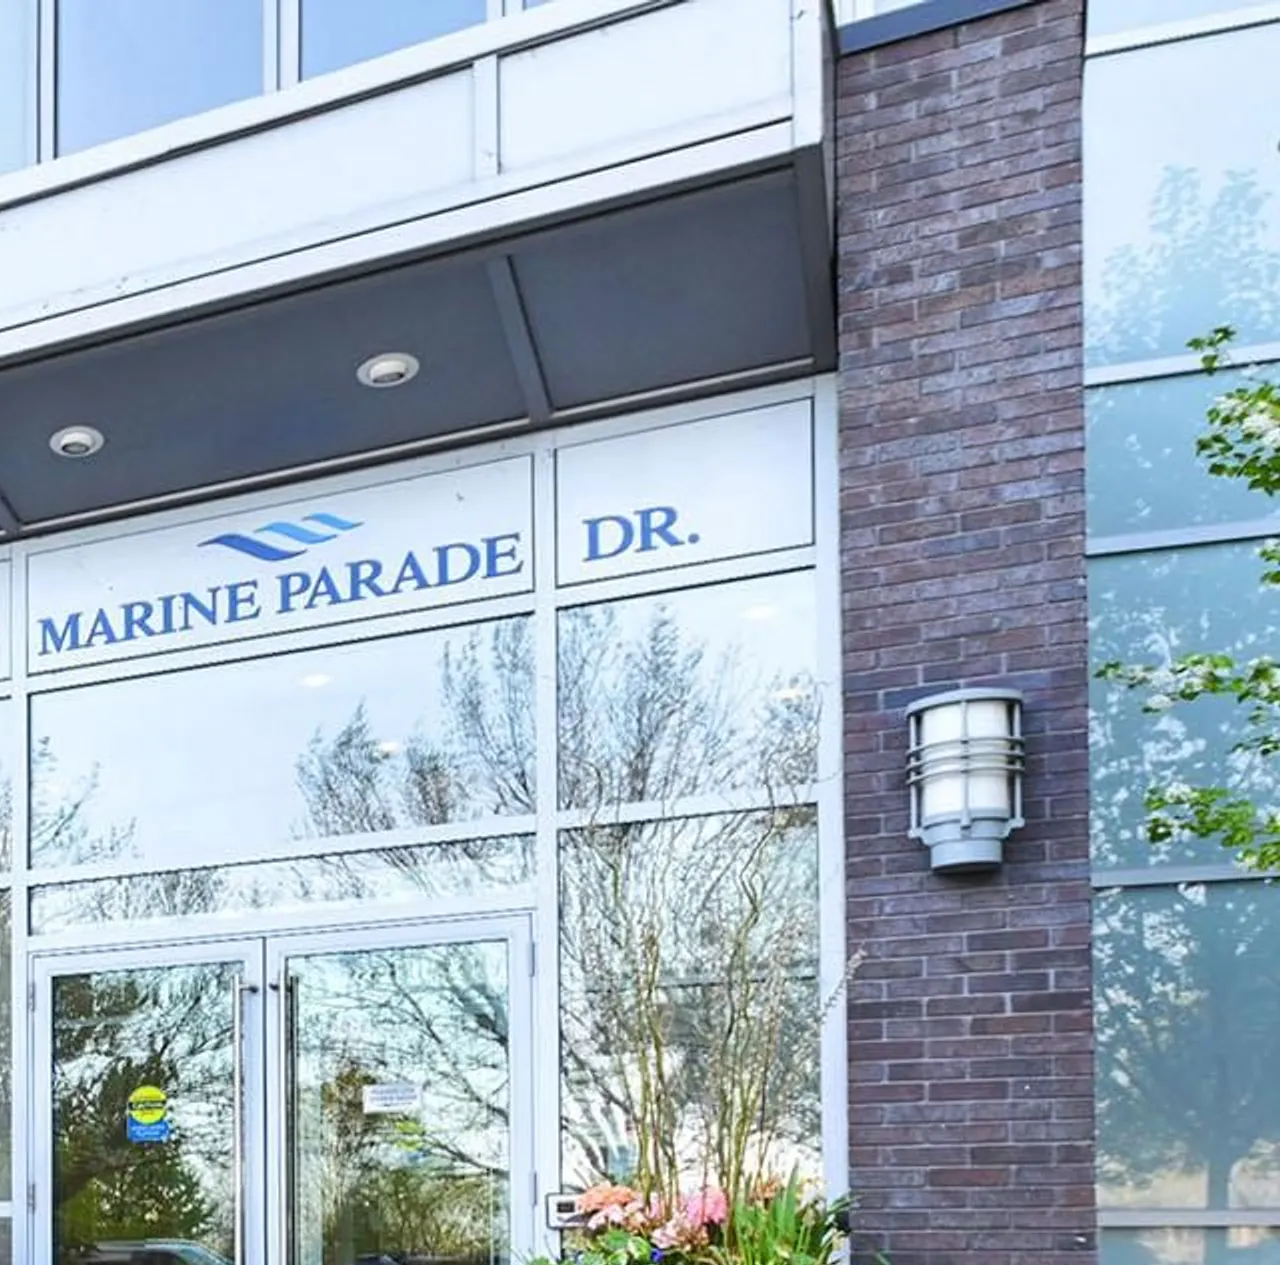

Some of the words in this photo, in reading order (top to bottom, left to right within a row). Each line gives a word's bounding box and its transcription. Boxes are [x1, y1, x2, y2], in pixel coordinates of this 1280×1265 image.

[37, 580, 263, 657] MARINE
[275, 532, 525, 614] PARADE
[582, 504, 700, 562] DR.
